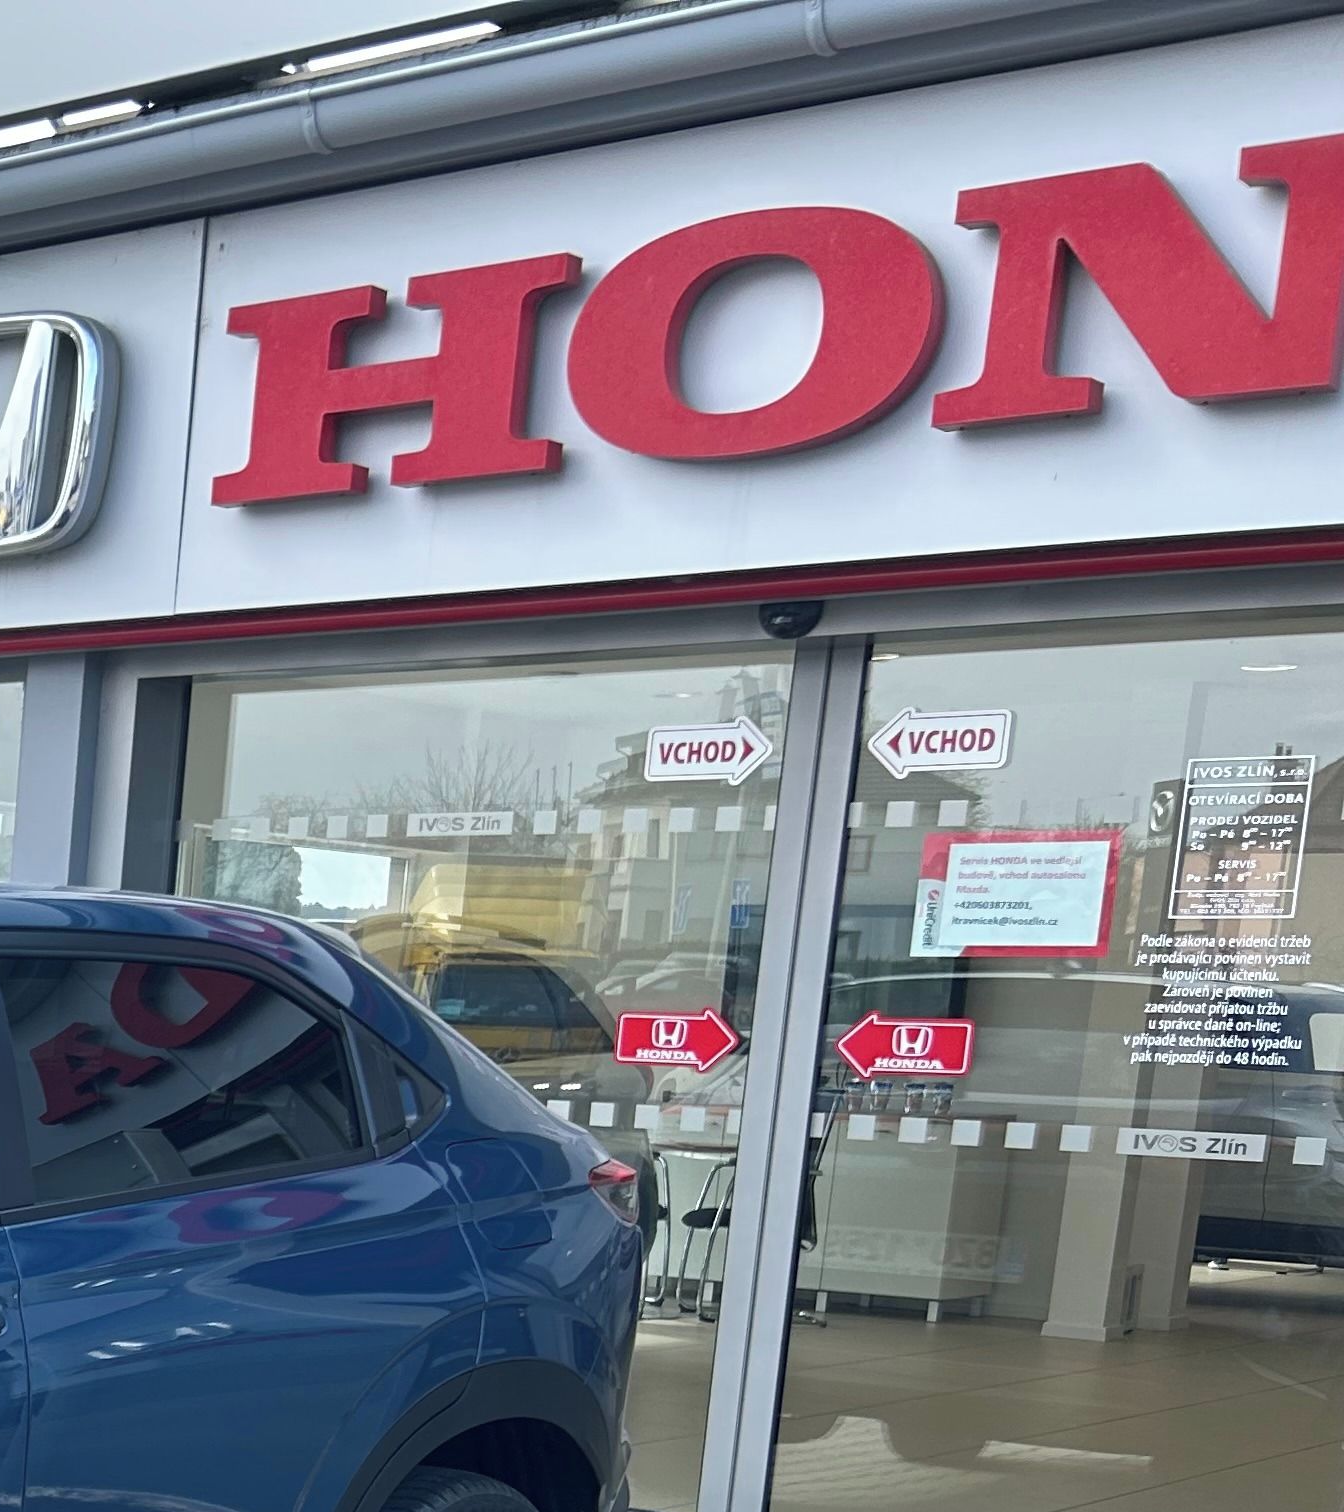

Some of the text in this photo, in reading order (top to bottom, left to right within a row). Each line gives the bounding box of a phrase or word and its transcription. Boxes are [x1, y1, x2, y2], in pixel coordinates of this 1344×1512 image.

[908, 727, 996, 755] VCHOD
[658, 740, 737, 765] VCHOD
[1193, 766, 1232, 778] IVOS
[1236, 763, 1278, 778] ZLÍN,
[1188, 791, 1305, 806] OTEVÍRACÍ DOBA
[1190, 814, 1299, 826] PRODEJ VOZIDEL
[991, 857, 1028, 865] HONDA
[1218, 860, 1257, 869] SERVIS
[1141, 934, 1311, 948] Podle zákona o evidenci tržeb
[1135, 951, 1148, 966] je
[1214, 952, 1262, 966] povinen
[1264, 952, 1311, 967] vystavit
[1230, 968, 1280, 982] účtenku.
[1163, 983, 1273, 1000] Zároveň je povinen
[1144, 1001, 1207, 1014] zaevidovat
[1257, 1001, 1289, 1016] tržbu
[1148, 1017, 1282, 1034] u správce daně on-line;
[1123, 1032, 1302, 1051] v případě technického výpadku
[635, 1048, 697, 1061] HONDA
[1130, 1050, 1289, 1067] pak nejpozději do 48 hodin.
[873, 1057, 944, 1070] HONDA
[1205, 1137, 1248, 1156] Zlín
